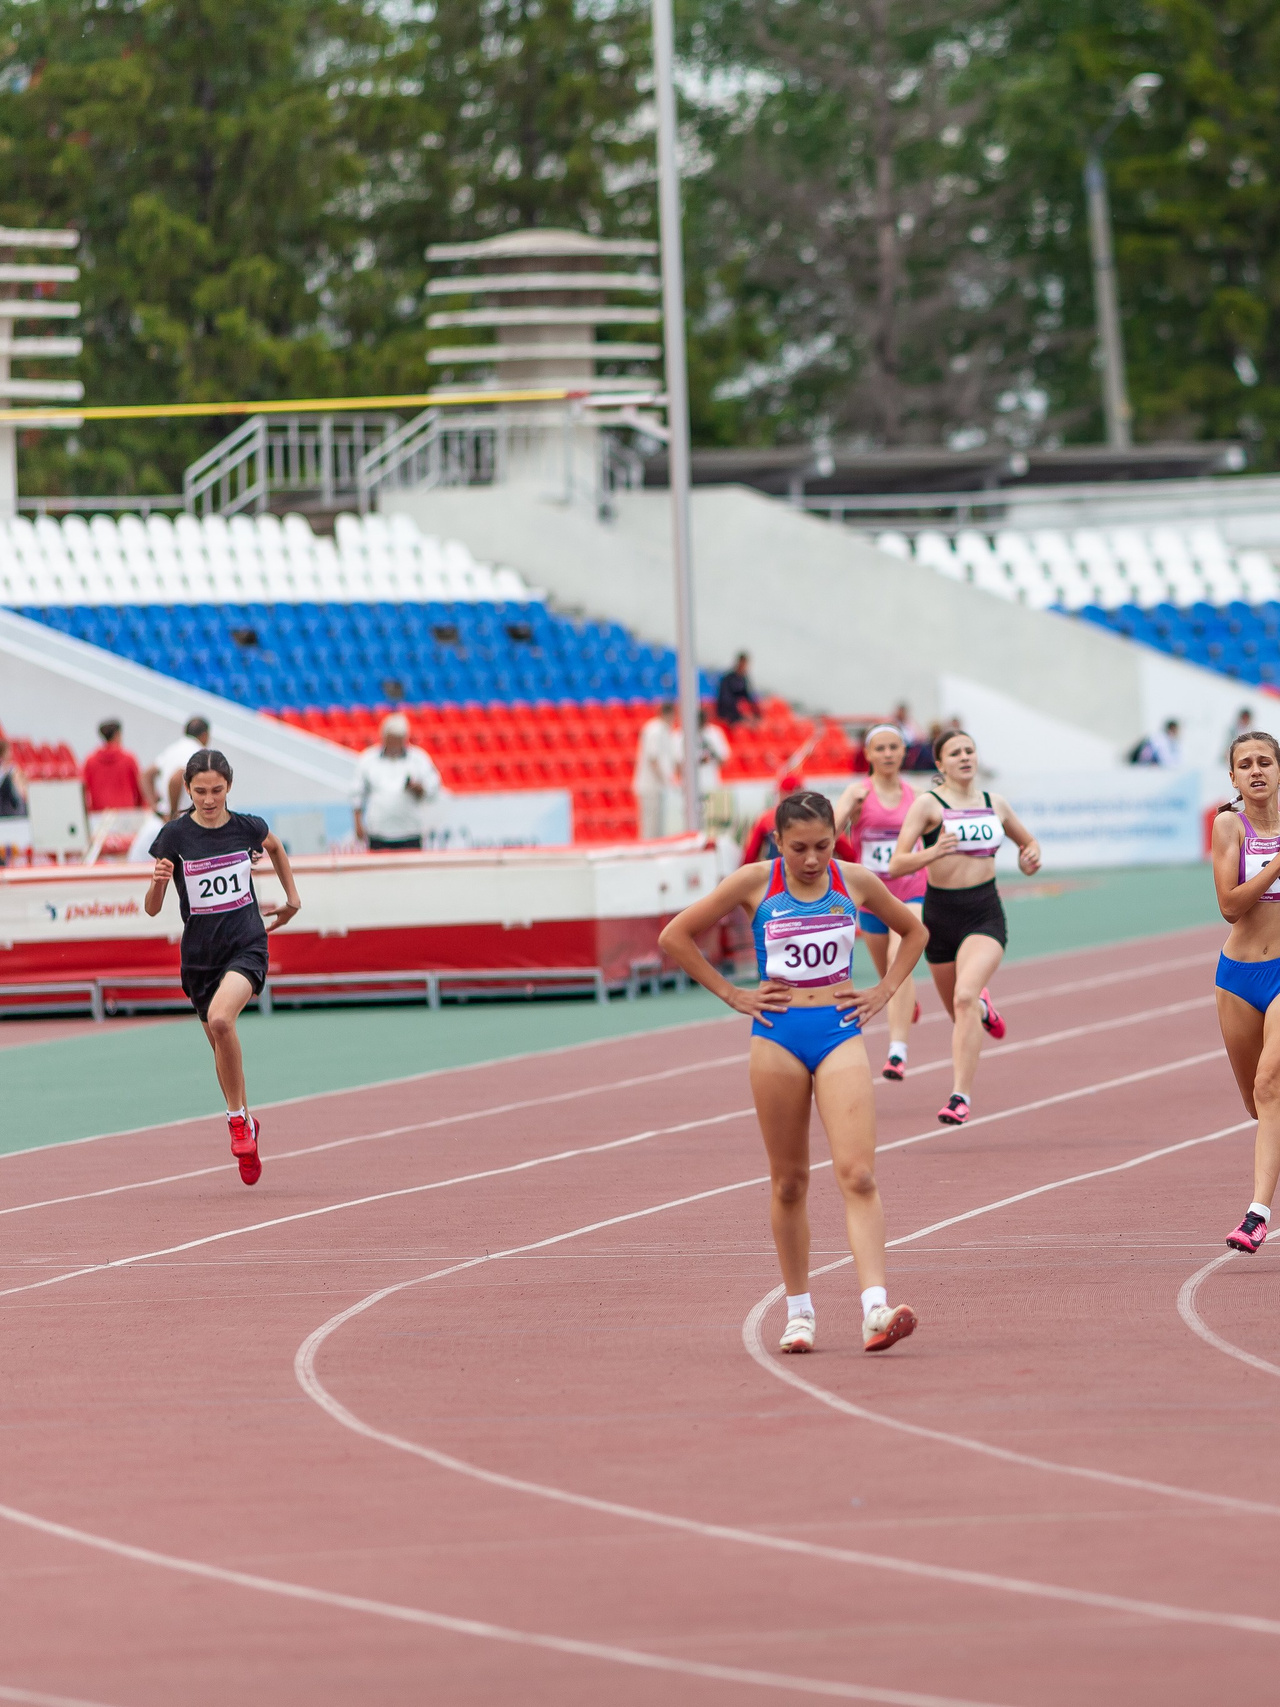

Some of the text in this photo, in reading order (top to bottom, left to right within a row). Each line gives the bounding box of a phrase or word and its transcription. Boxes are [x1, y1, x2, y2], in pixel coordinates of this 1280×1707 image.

[957, 824, 994, 842] 120
[872, 846, 892, 864] 41
[198, 873, 242, 899] 201
[784, 941, 838, 968] 300
